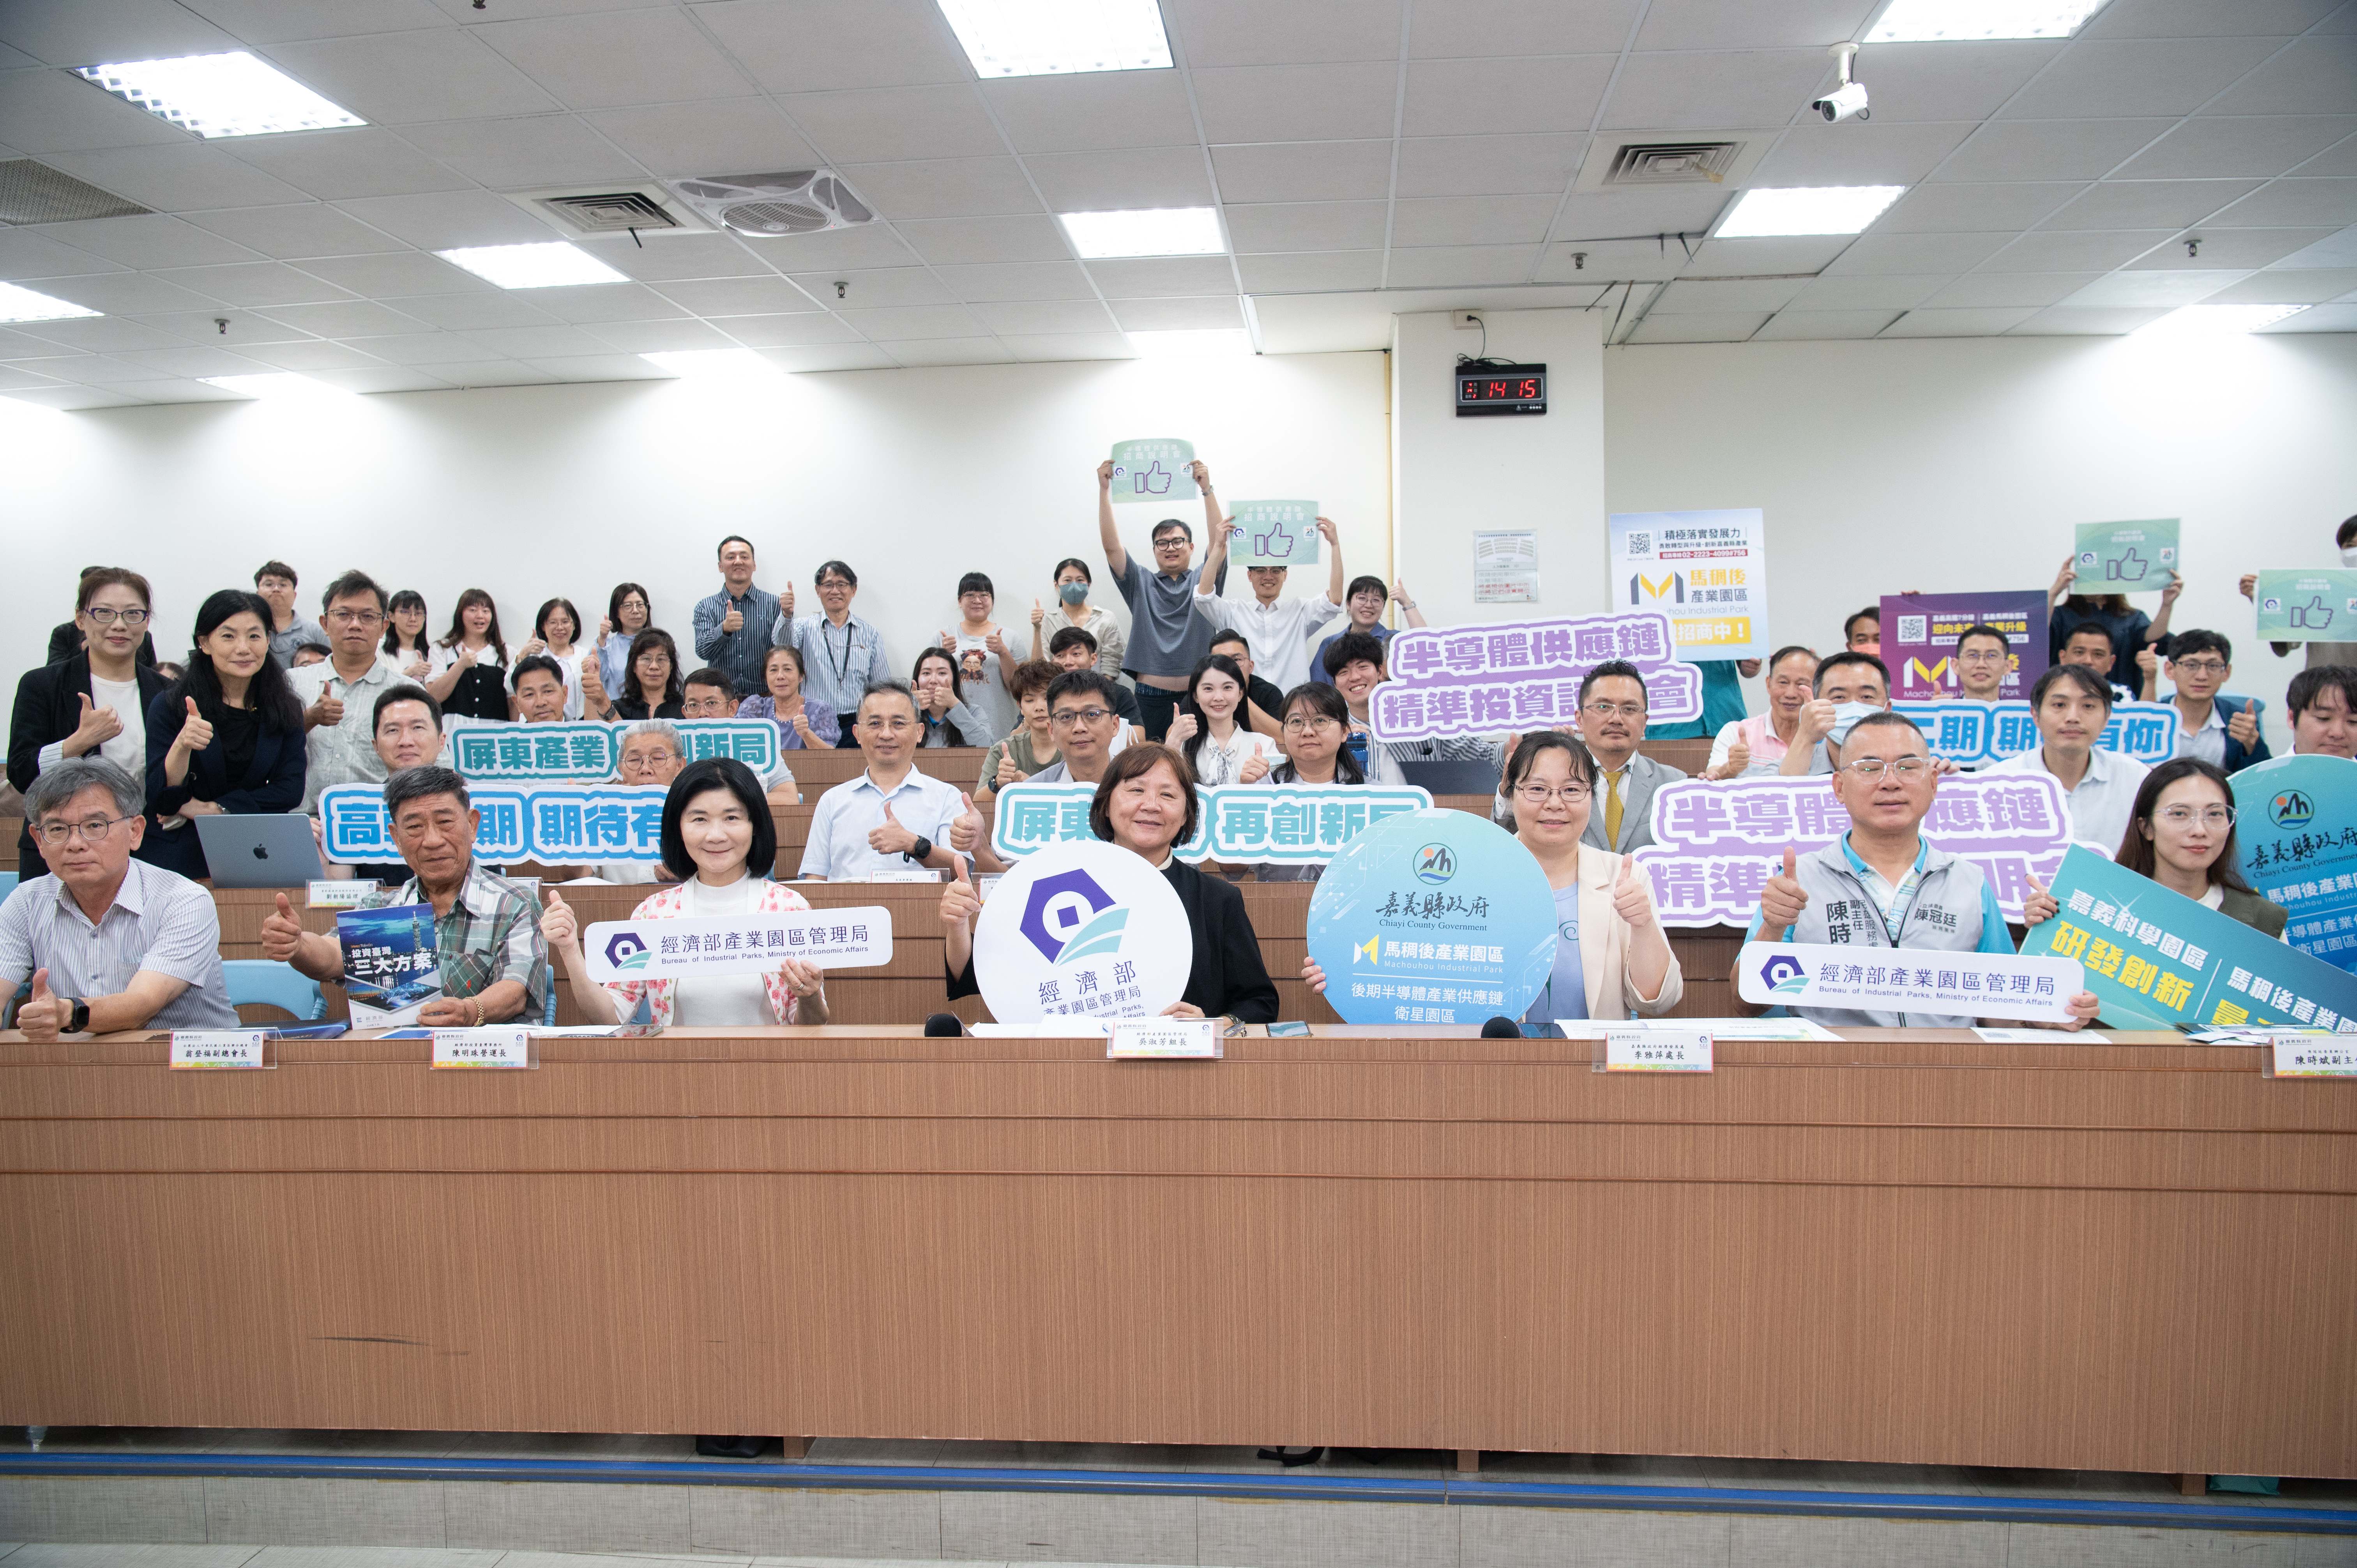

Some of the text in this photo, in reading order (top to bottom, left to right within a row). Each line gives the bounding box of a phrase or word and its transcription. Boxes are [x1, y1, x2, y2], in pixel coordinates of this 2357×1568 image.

[1489, 380, 1535, 398] 14 15
[1124, 450, 1180, 461] 招商說明會
[1244, 512, 1304, 521] 招商說明會
[1664, 528, 1740, 540] 積極落實發展力
[1690, 568, 1746, 586] 馬稠後
[1691, 588, 1748, 603] 產業園區
[1688, 606, 1727, 614] Industrial
[1675, 622, 1744, 641] 招商中！
[1402, 622, 1662, 674] 半導體供應鏈
[1383, 674, 1687, 728] 精準投資會
[463, 735, 606, 770] 屏東產業
[1672, 787, 2049, 838] 半導體應鏈
[336, 804, 517, 847] 高期
[2254, 867, 2279, 878] Chiayi
[2282, 861, 2311, 874] County
[2267, 872, 2357, 904] 馬稠後產業
[1376, 891, 1489, 920] 嘉義縣政府
[1849, 900, 1864, 931] 副主任
[1914, 908, 1957, 927] 陳冠廷
[1379, 919, 1487, 931] Chiayi County Government
[2067, 888, 2209, 971] 嘉義科學園區
[661, 925, 868, 954] 經濟部產業園區管理局
[352, 946, 391, 958] 投資臺灣
[704, 954, 737, 962] Industrial
[742, 952, 764, 961] Parks,
[768, 950, 796, 959] Ministry
[809, 947, 843, 955] Economic
[1384, 941, 1504, 962] 馬稠後產業園區
[355, 952, 432, 975] 三大方案
[1384, 961, 1503, 974] Machouhou Industrial Park
[2050, 920, 2194, 1012] 研發創新
[1038, 961, 1136, 1005] 經濟部
[1820, 962, 2054, 996] 經濟部產業園區管理局
[1351, 982, 1503, 1006] 後期半導體產業供應鏈
[1865, 989, 1901, 997] Industrial
[1907, 991, 1932, 999] Parks,
[1936, 993, 1968, 1002] Ministry
[1982, 996, 2023, 1004] Economic
[1122, 1004, 1143, 1013] Parks,
[1394, 1005, 1455, 1024] 衛星園區
[1139, 1038, 1187, 1046] 吳淑芳組長
[186, 1049, 247, 1058] 翁登福副總會長
[452, 1049, 507, 1058] 陳明珠營運長
[1634, 1051, 1685, 1060] 李雅萍處長
[2295, 1055, 2357, 1065] 陳時斌副主
